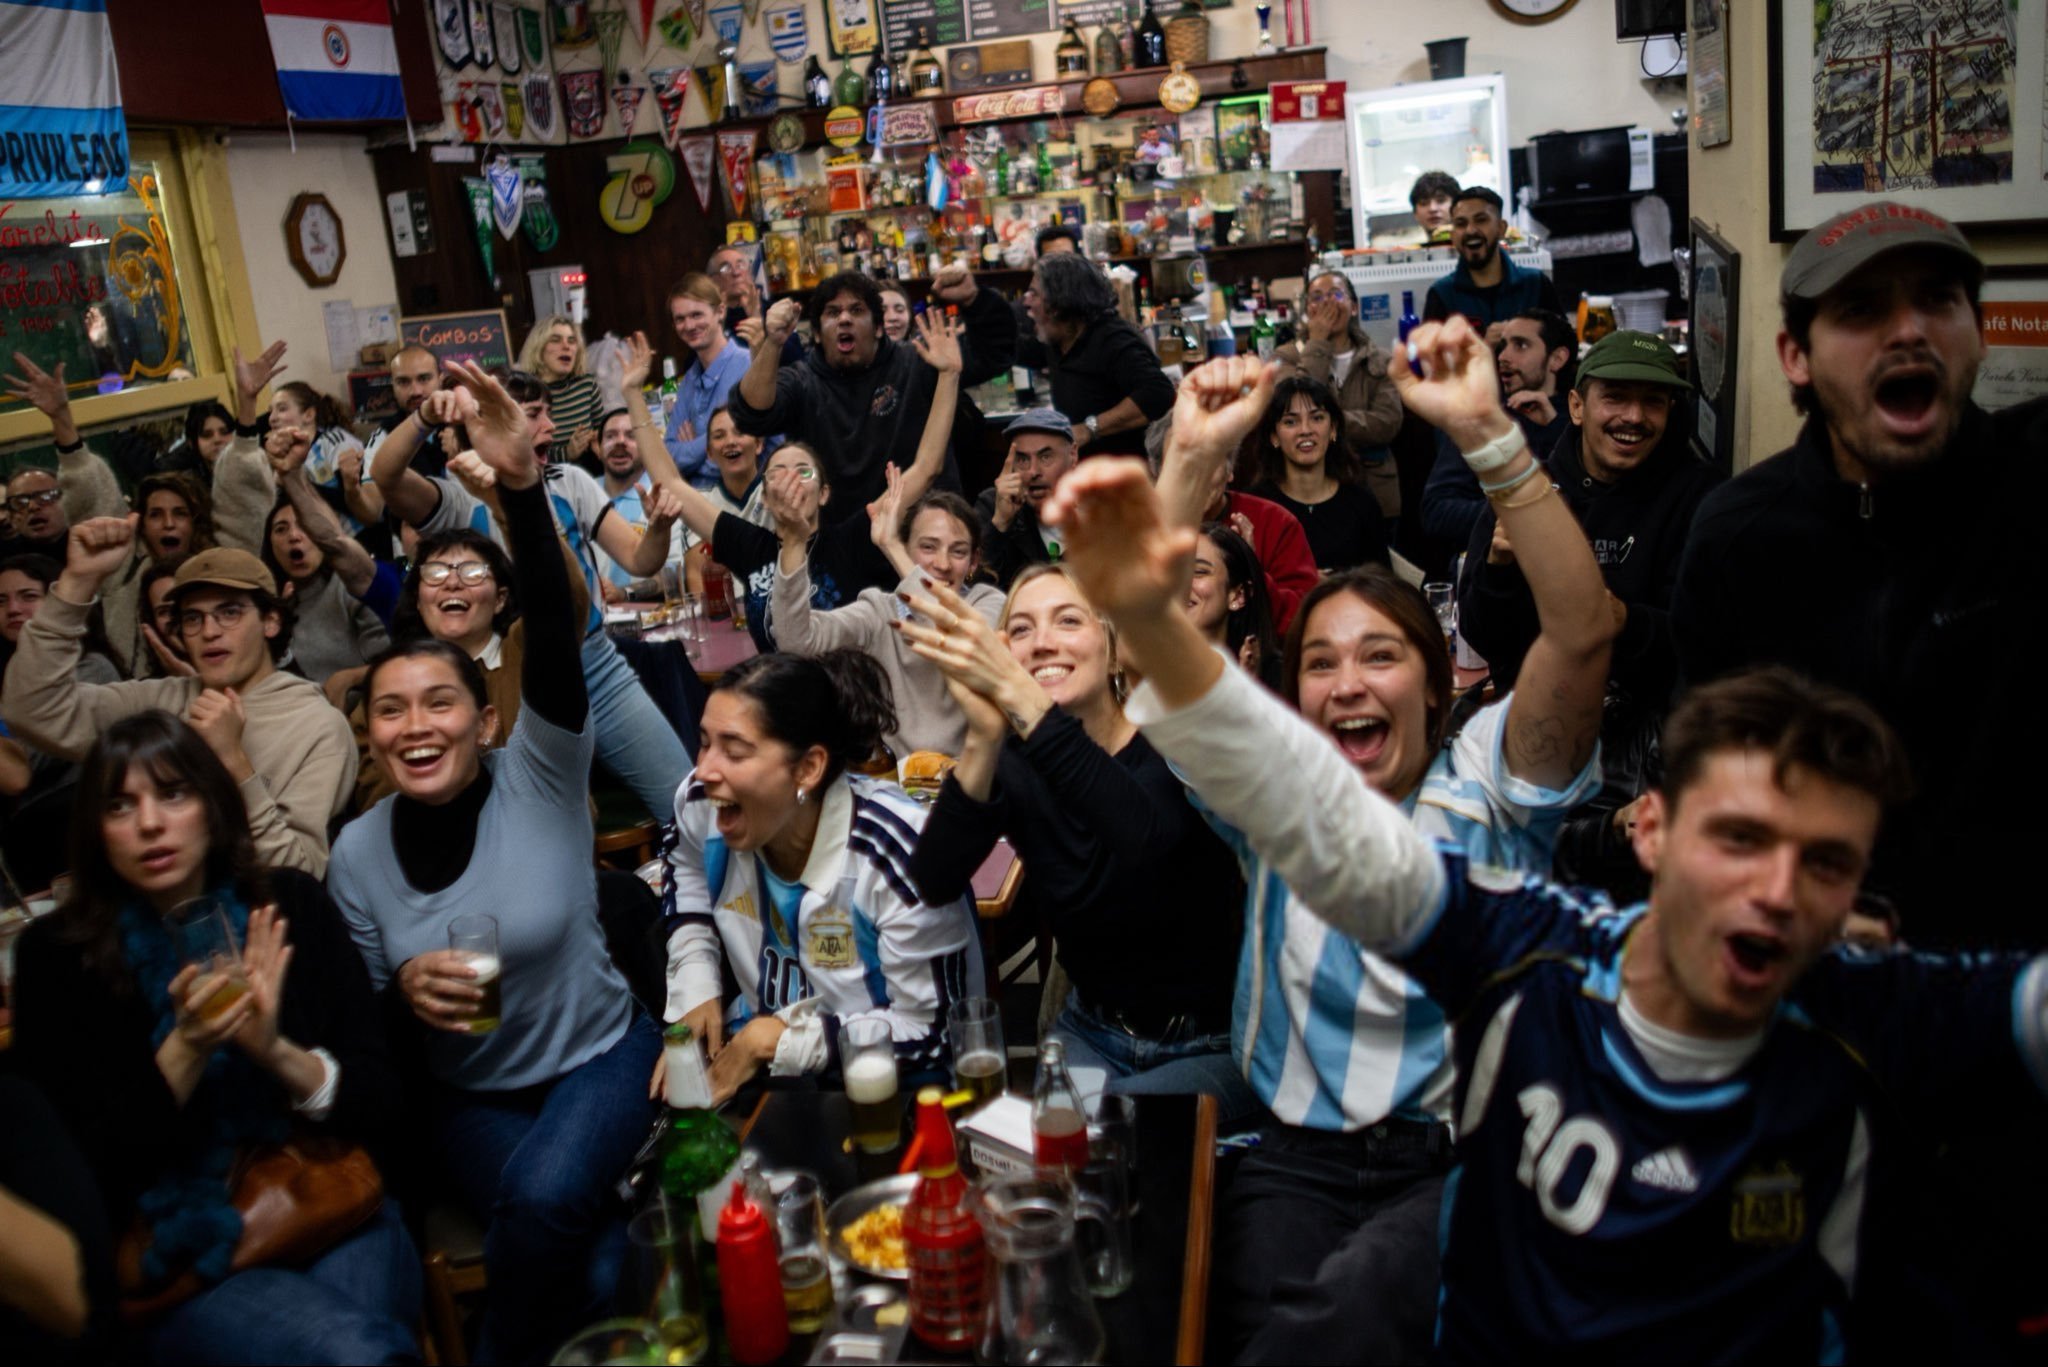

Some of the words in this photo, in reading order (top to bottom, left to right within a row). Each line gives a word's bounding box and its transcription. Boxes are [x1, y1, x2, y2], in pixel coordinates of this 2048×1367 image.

[632, 181, 654, 195] UP
[1983, 315, 2008, 332] afé
[817, 936, 844, 956] AFA
[764, 946, 809, 1009] 10
[1515, 1084, 1621, 1237] 10
